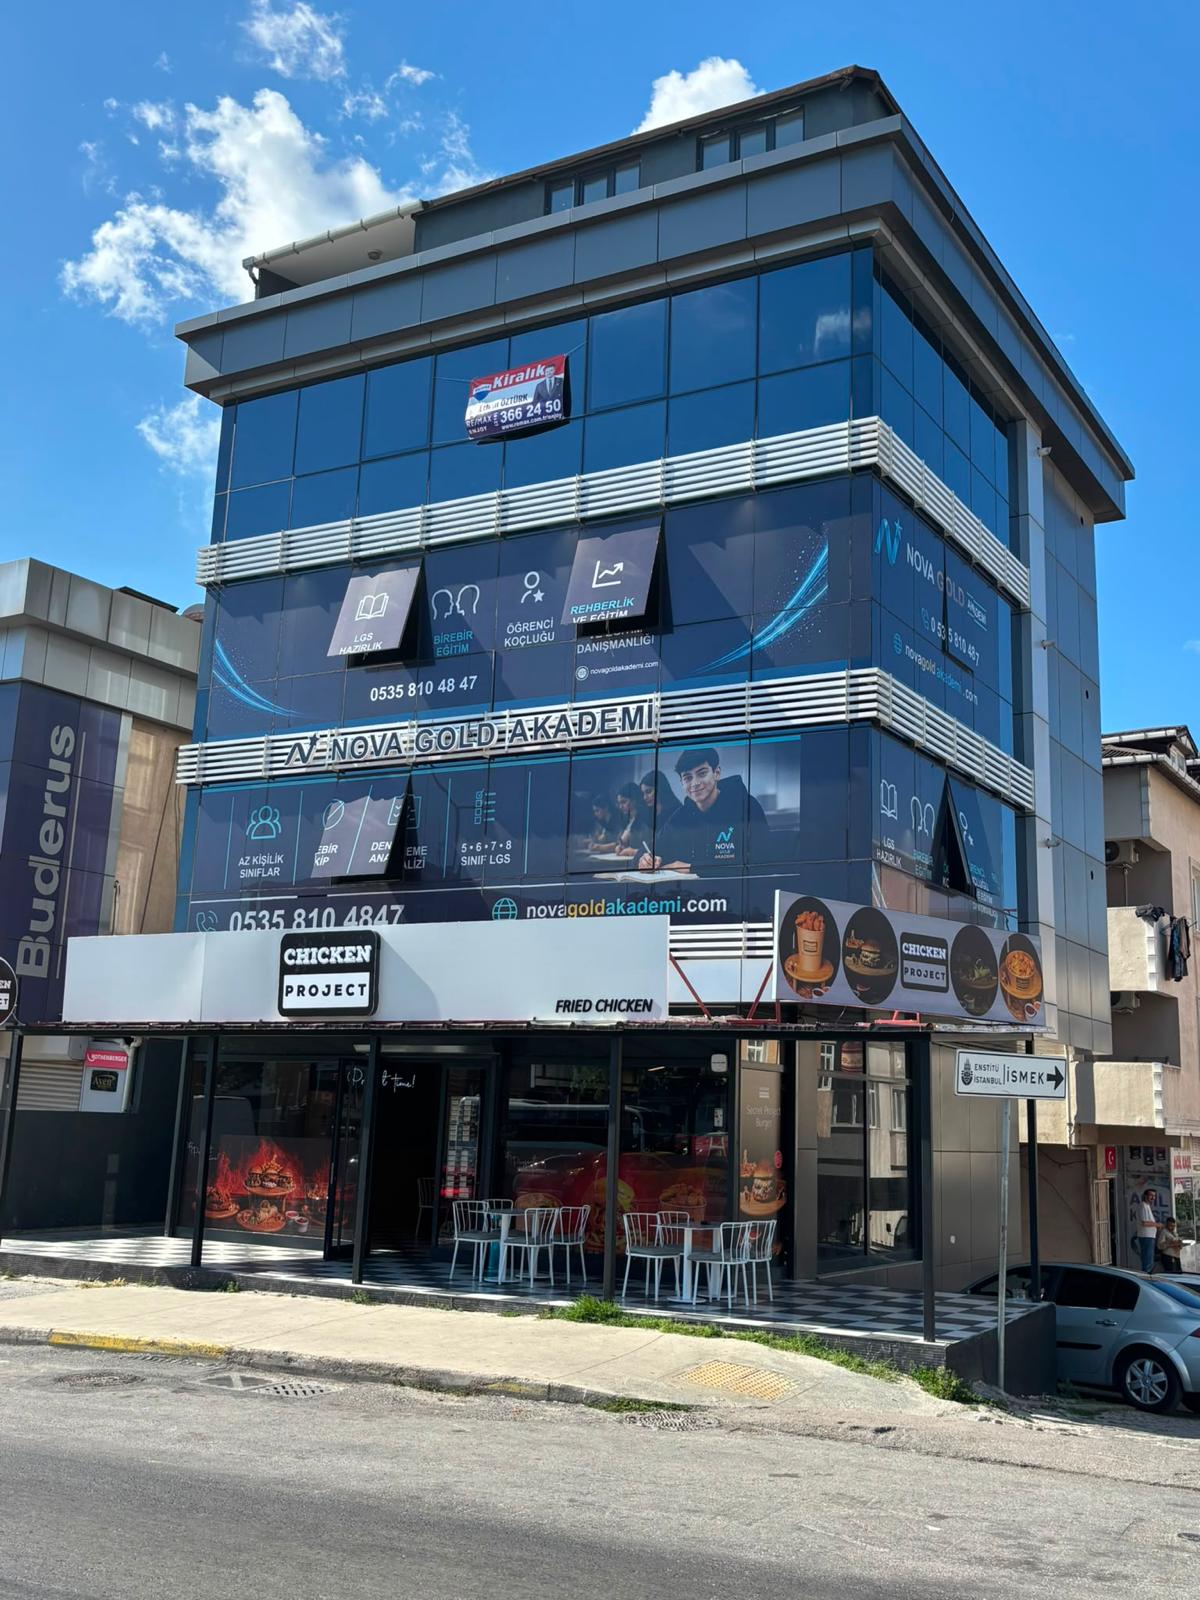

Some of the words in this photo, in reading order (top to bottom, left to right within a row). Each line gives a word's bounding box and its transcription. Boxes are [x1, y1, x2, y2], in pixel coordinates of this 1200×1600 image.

[493, 364, 545, 389] Kiralık
[500, 407, 522, 424] 366
[526, 404, 542, 418] 24
[545, 398, 561, 414] 50
[906, 542, 935, 584] NOVA
[570, 596, 635, 615] REHBERLİK
[506, 616, 554, 635] ÖĞRENCİ
[354, 632, 374, 643] LGS
[433, 629, 473, 644] BİREBİR
[504, 631, 555, 648] KOÇLUĞU
[576, 633, 655, 654] DANIŞMANLIĞI
[339, 641, 383, 655] HAZIRLIK
[436, 643, 469, 657] EĞİTİM
[370, 684, 404, 701] 0535
[408, 680, 434, 697] 810
[437, 678, 455, 694] 48
[459, 675, 478, 691] 47
[330, 734, 403, 763] NOVA
[414, 721, 499, 755] GOLD
[508, 702, 655, 744] AKADEMİ
[16, 724, 77, 979] Buderus
[715, 842, 735, 850] NOVA
[238, 856, 250, 867] AZ
[252, 853, 284, 867] KİŞİLİK
[460, 855, 487, 867] SINIF
[489, 853, 511, 865] LGS
[239, 867, 281, 879] SINIFLAR
[526, 895, 728, 920] novagoldakademi.com
[229, 909, 286, 932] 0535
[292, 906, 336, 930] 810
[343, 904, 406, 927] 4847
[283, 944, 373, 966] CHICKEN
[901, 941, 947, 960] CHICKEN
[903, 966, 947, 982] PROJECT
[284, 983, 367, 998] PROJECT
[555, 998, 592, 1014] FRIED
[595, 998, 654, 1014] CHICKEN
[974, 1063, 1000, 1073] ENSTİTÜ
[1006, 1066, 1045, 1085] İSMEK
[973, 1073, 1003, 1086] İSTANBUL
